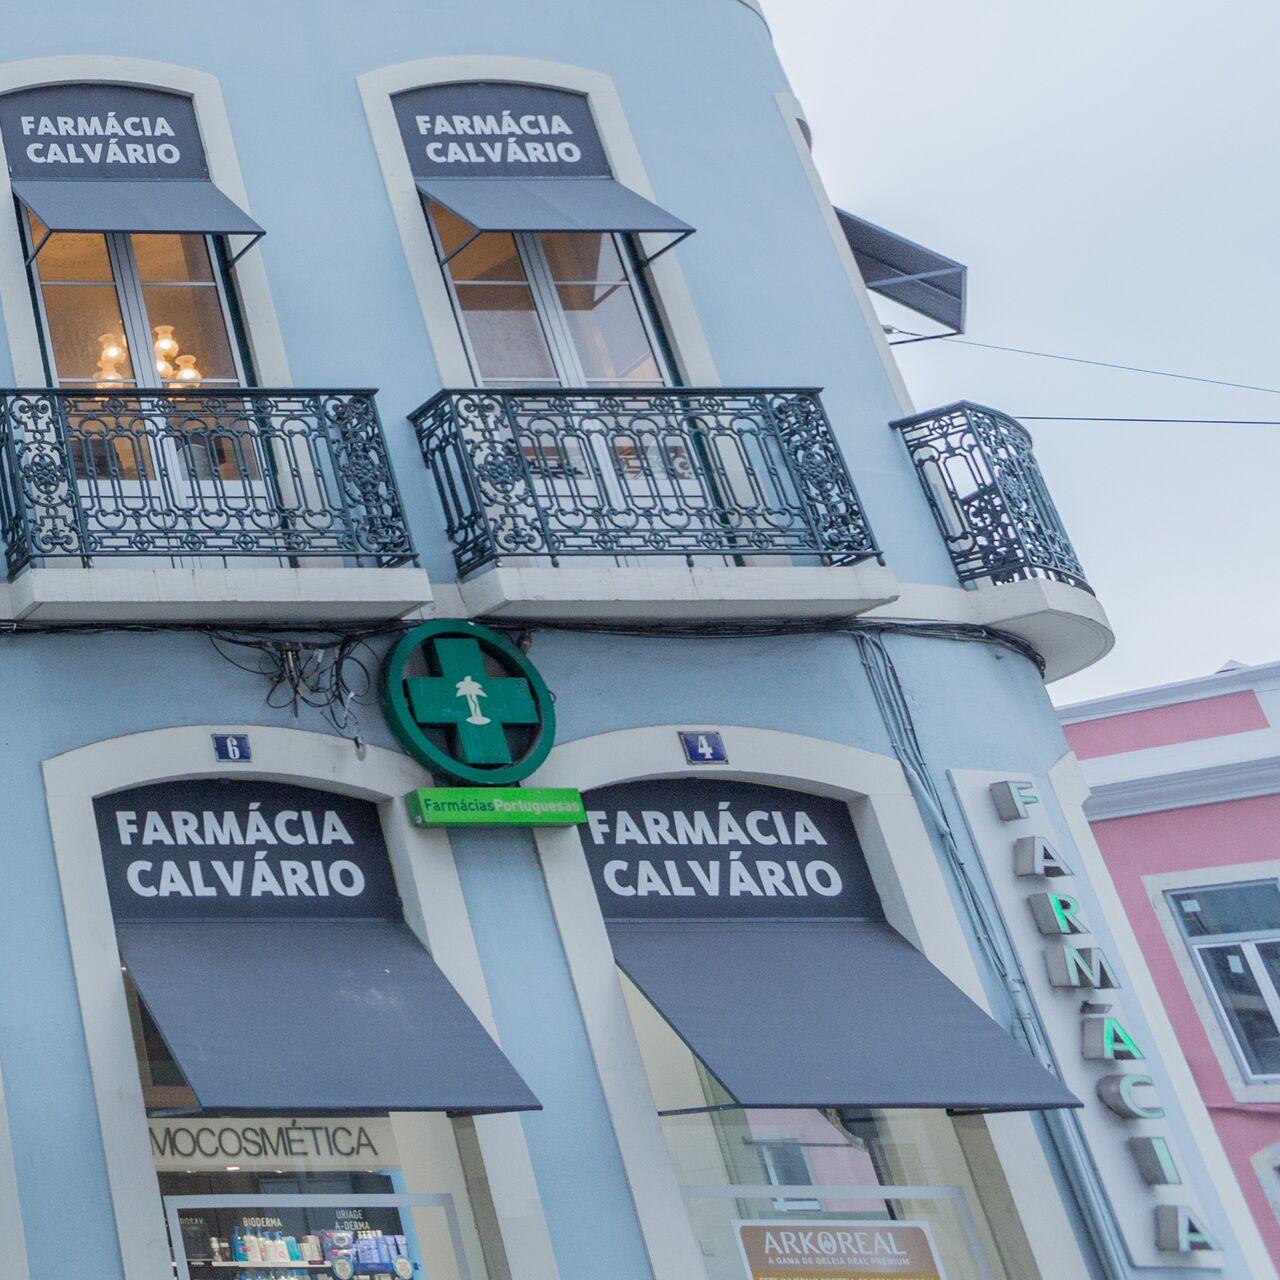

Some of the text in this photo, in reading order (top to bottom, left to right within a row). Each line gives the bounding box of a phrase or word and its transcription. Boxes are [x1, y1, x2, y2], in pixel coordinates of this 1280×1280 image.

[20, 111, 176, 137] FARMÁCIA
[415, 110, 574, 136] FARMÁCIA
[26, 138, 181, 165] CALVÁRIO
[425, 137, 582, 164] CALVÁRIO
[226, 736, 241, 760] 6
[698, 735, 713, 759] 4
[115, 801, 355, 846] FARMÁCIA
[585, 801, 828, 846] FARMÁCIA
[126, 850, 366, 898] CALVÁRIO
[602, 850, 843, 897] CALVÁRIO
[990, 780, 1223, 1252] FARMÁCIA
[242, 1216, 284, 1228] BIODERMA
[335, 1209, 363, 1220] URIAGE
[764, 1230, 908, 1256] ARKOREAL
